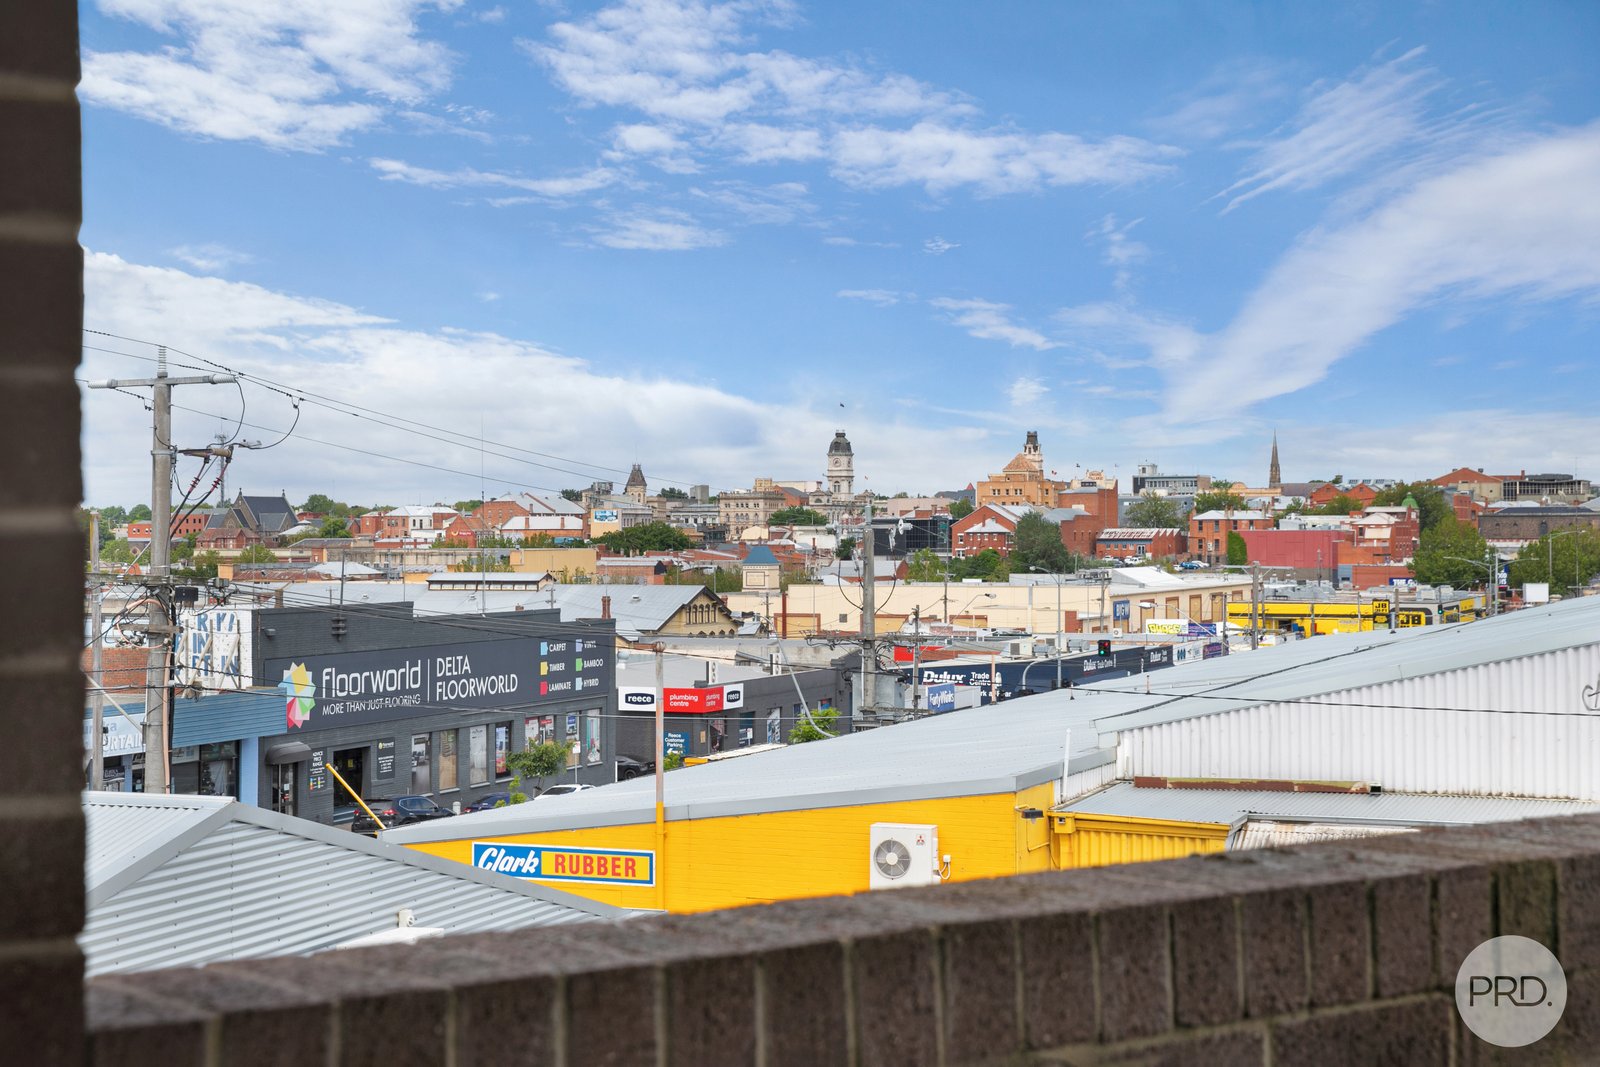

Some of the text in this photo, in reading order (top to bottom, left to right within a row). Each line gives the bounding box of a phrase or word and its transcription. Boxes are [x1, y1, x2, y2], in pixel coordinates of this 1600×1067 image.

[1400, 614, 1422, 625] JB
[549, 643, 566, 652] CARPET
[436, 654, 471, 677] DELTA
[549, 662, 565, 672] TIMBER
[583, 658, 604, 668] BAMBOO
[322, 659, 421, 698] floorworld
[922, 670, 963, 684] Dulux
[970, 671, 990, 680] Trade
[436, 673, 518, 702] FLOORWORLD
[548, 681, 572, 692] LAMINATE
[583, 678, 599, 687] HYBRID
[969, 678, 992, 687] Centre
[627, 695, 652, 703] reece
[669, 694, 699, 702] plumbing
[705, 693, 721, 701] plumbing
[727, 692, 740, 701] reece
[322, 694, 421, 716] MORE THAN JUST FLOORING
[478, 847, 637, 878] Clark RUBBER
